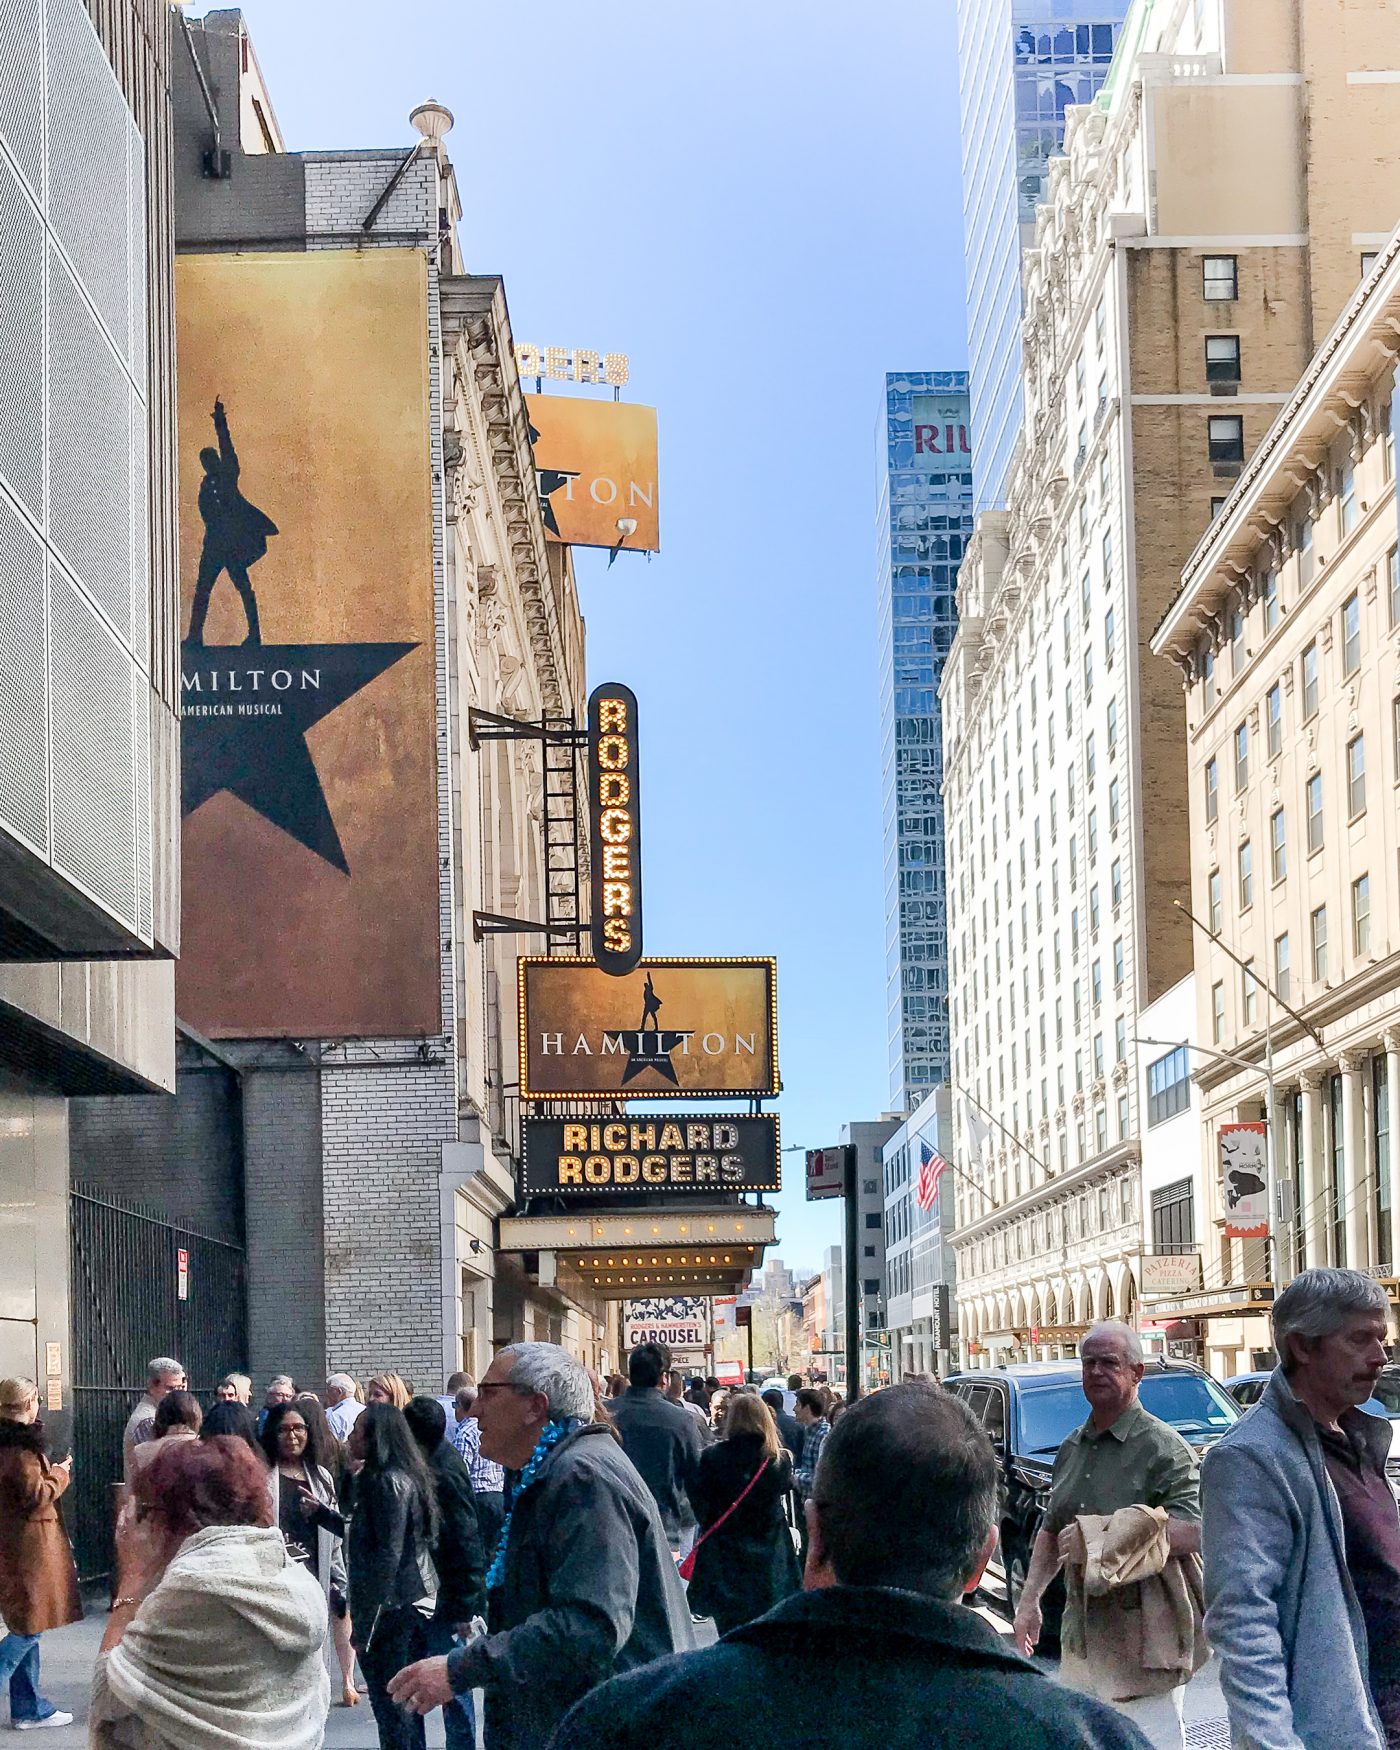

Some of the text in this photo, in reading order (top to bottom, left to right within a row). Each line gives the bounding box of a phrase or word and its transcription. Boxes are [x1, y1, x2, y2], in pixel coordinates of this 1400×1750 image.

[181, 669, 321, 692] MILTON
[181, 703, 283, 716] AMERICAN MUSICAL
[598, 698, 633, 953] RODGERS
[540, 1032, 756, 1055] HAMILTON
[563, 1123, 739, 1151] RICHARD
[558, 1154, 746, 1184] RODGERS
[1144, 1257, 1197, 1276] PATZERIA
[932, 1286, 941, 1349] PARAMOUNT HOTEL
[630, 1329, 702, 1345] CAROUSEL
